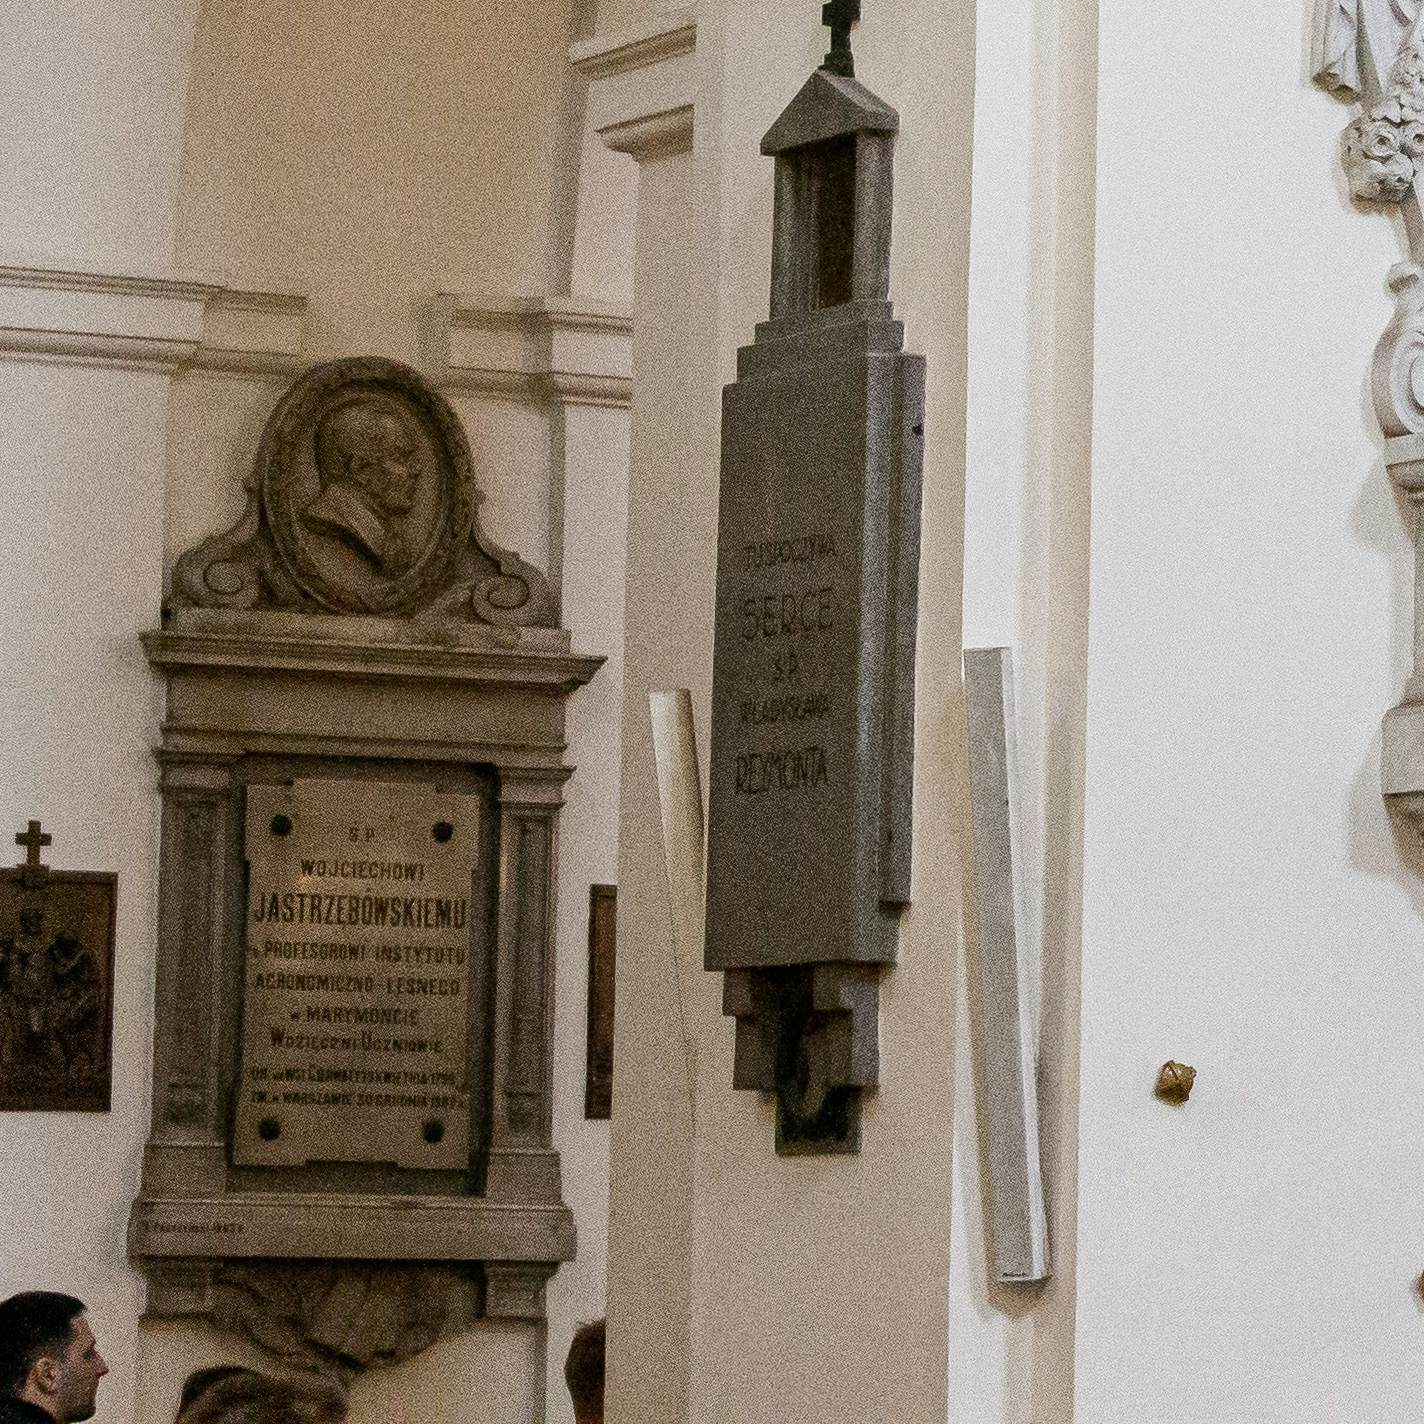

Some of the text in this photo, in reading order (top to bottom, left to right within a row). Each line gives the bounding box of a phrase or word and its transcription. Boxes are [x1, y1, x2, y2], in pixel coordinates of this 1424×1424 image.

[301, 859, 426, 882] WOJCIECHOWI
[264, 940, 466, 965] PROFESOROWI INSTYTUTU
